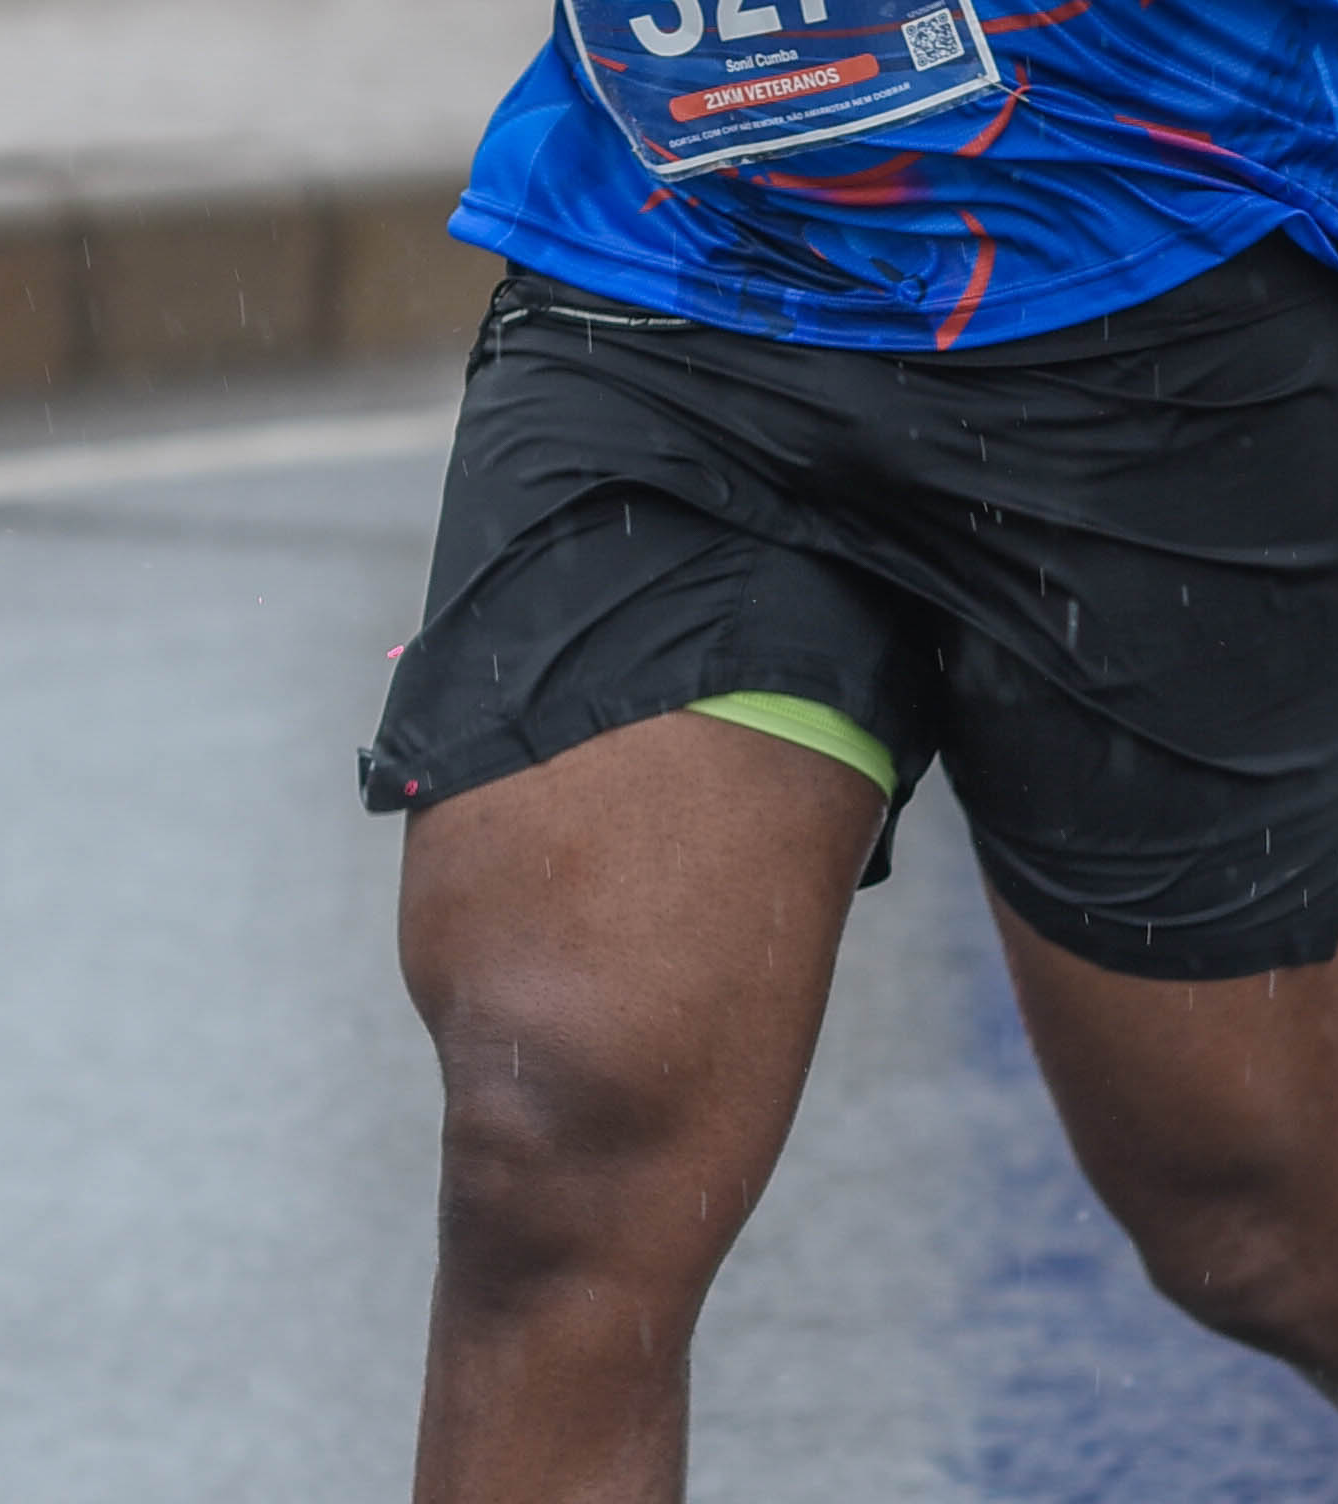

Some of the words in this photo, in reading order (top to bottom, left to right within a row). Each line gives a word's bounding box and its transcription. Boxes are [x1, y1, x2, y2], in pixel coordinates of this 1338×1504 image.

[725, 55, 754, 73] Sonil
[755, 49, 799, 68] Cumba
[704, 87, 745, 110] 21KM
[744, 67, 841, 102] VETERANOS
